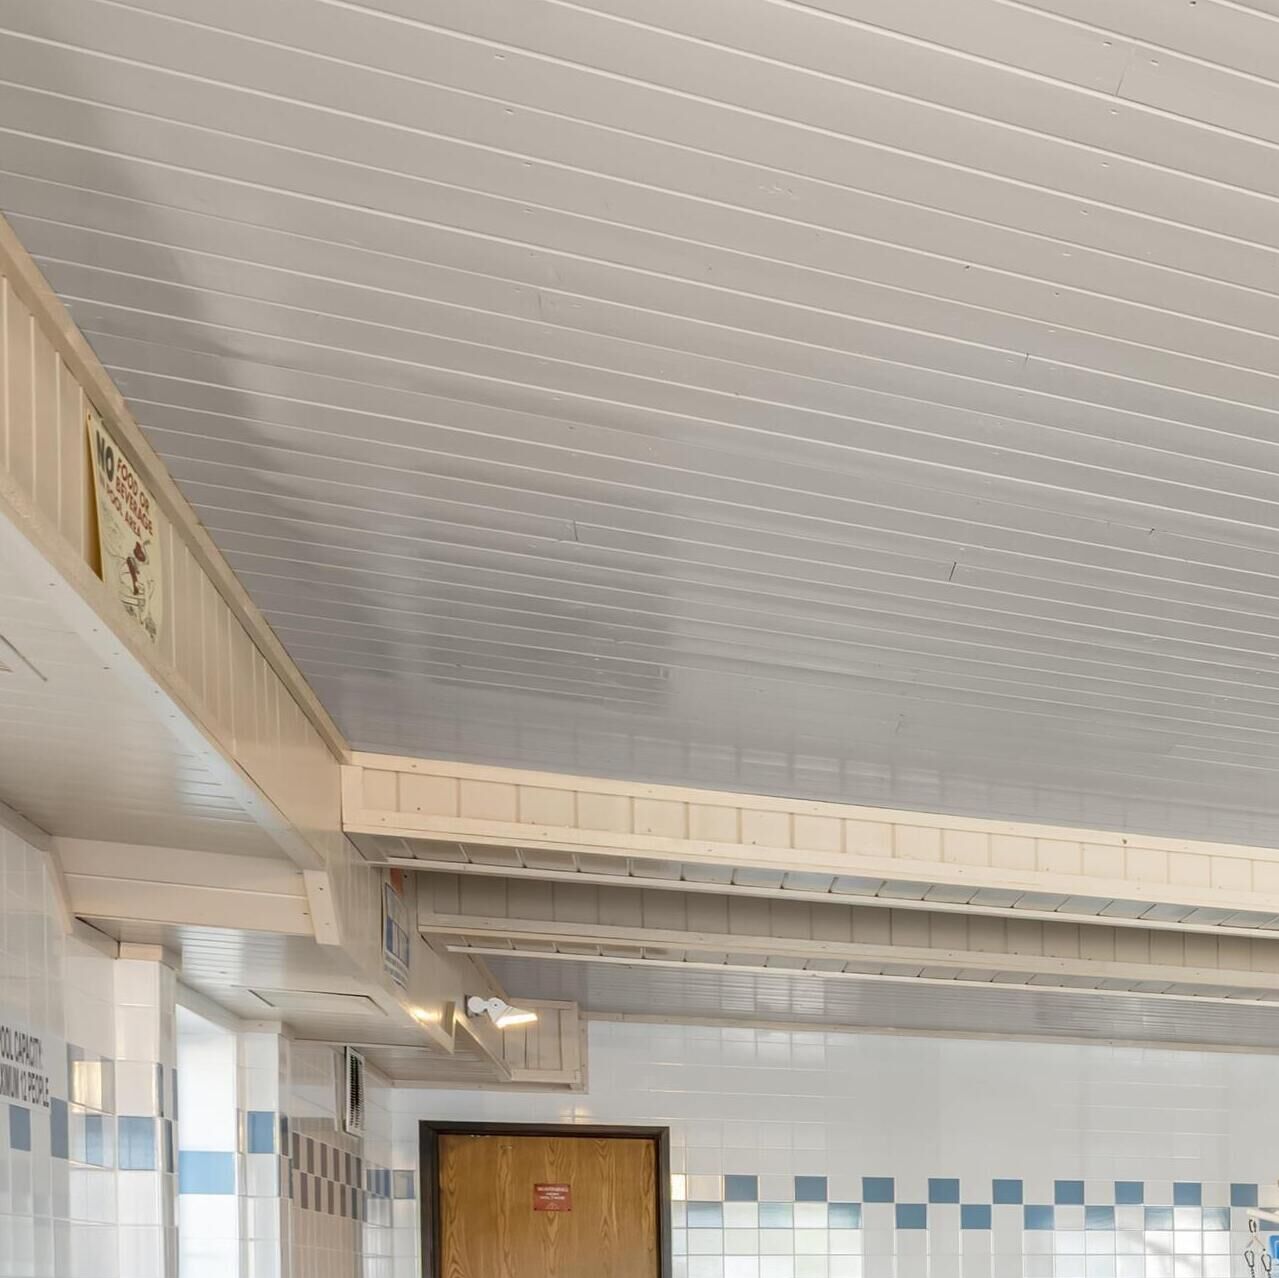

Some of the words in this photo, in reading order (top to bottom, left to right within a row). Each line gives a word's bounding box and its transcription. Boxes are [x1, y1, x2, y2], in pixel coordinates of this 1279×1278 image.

[96, 430, 114, 482] NO
[117, 458, 138, 496] FOOD
[116, 476, 153, 535] BEVERAGE
[0, 1025, 14, 1061] OOL
[27, 1071, 49, 1108] PEOPLE
